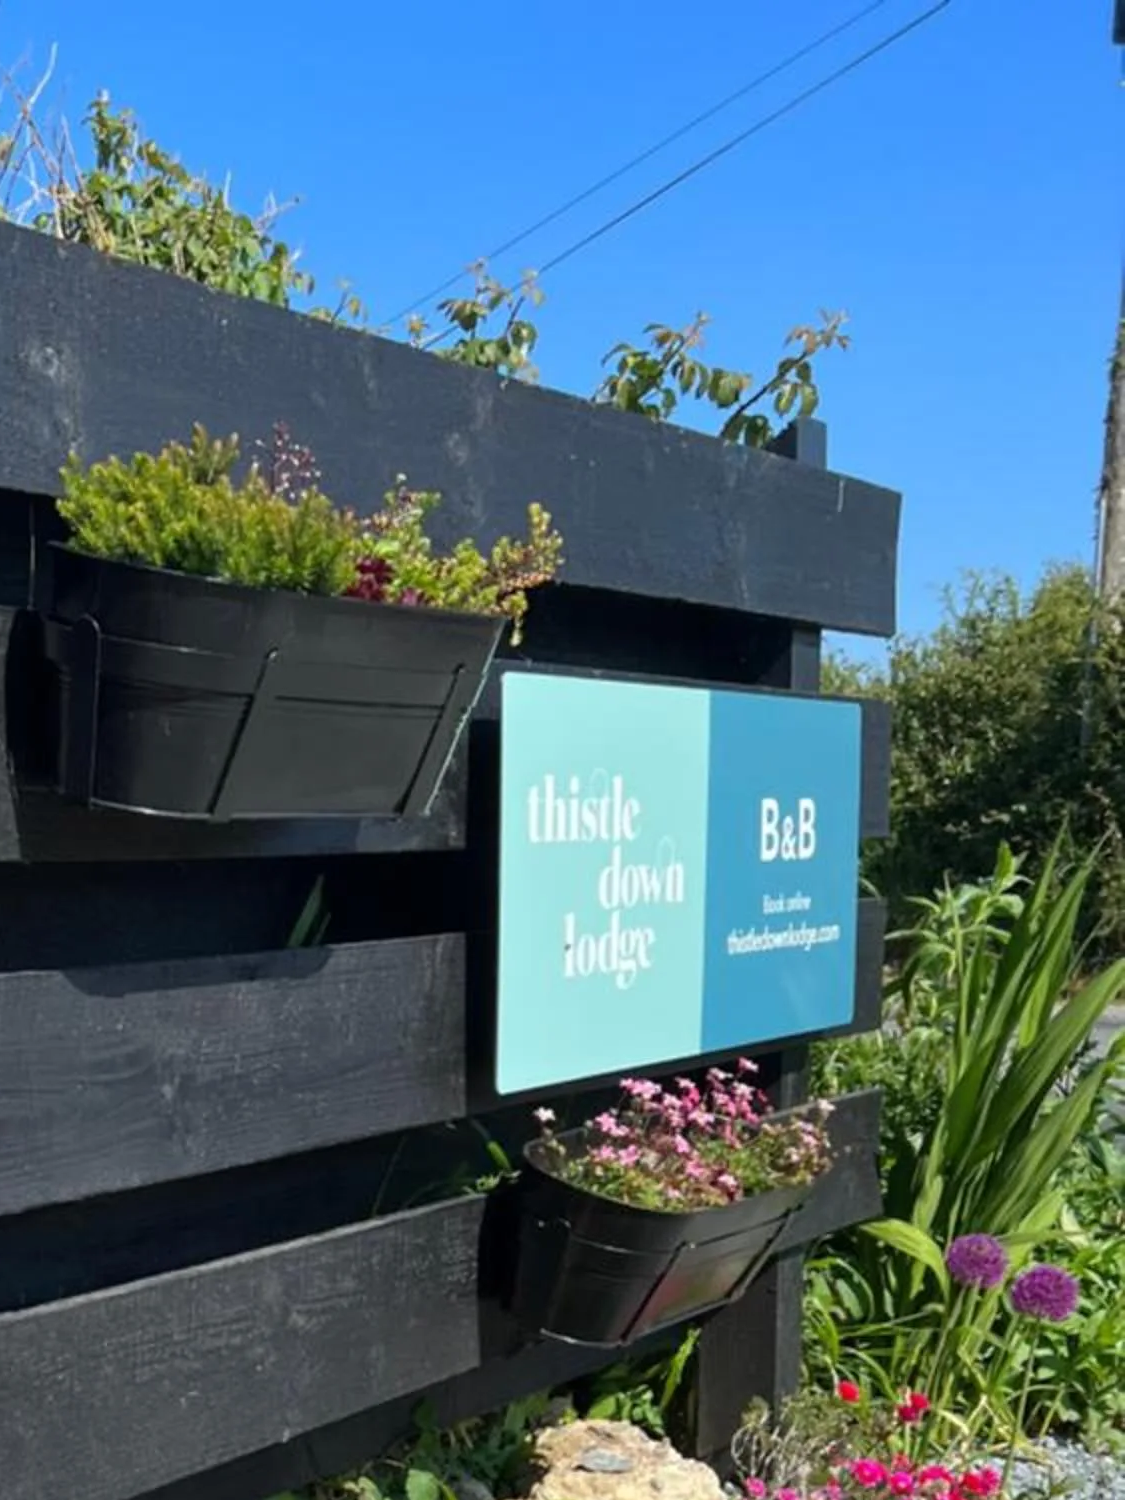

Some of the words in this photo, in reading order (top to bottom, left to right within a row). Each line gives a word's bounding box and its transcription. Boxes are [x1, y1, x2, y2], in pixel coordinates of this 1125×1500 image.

[527, 773, 641, 843] thistle
[760, 797, 816, 862] B&B
[598, 844, 684, 910] down
[762, 894, 784, 914] Book
[786, 891, 812, 912] online
[563, 912, 655, 990] lodge
[726, 921, 840, 955] thistledownlodge.com
